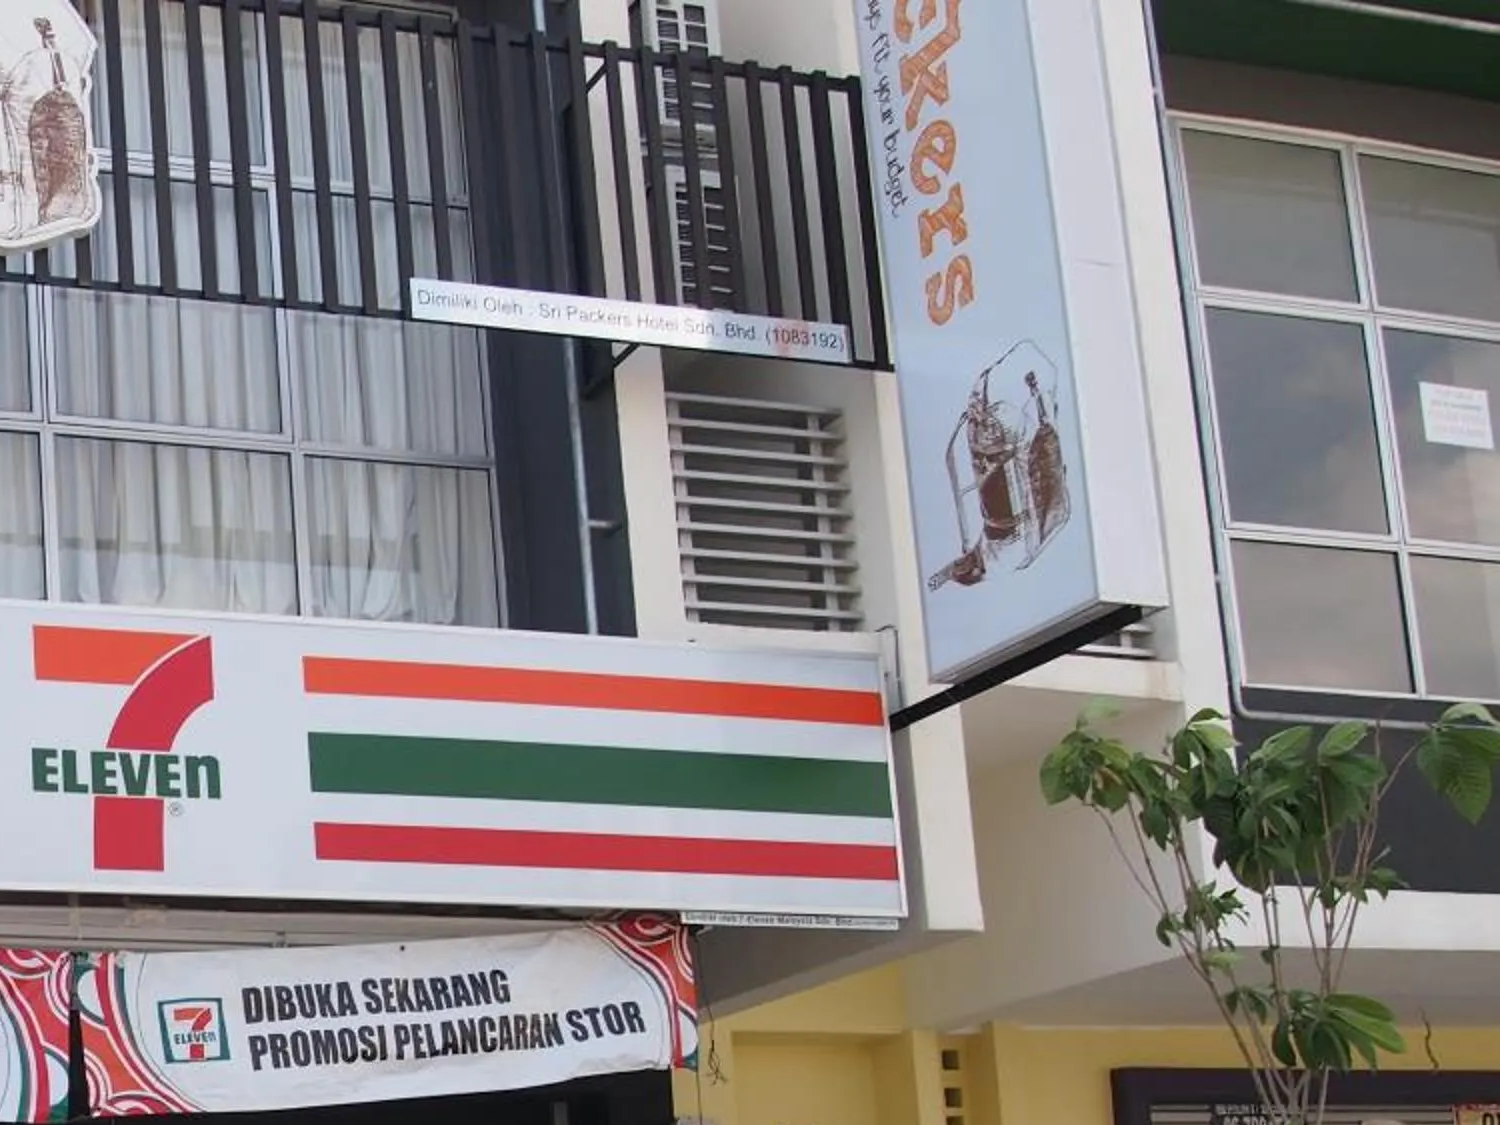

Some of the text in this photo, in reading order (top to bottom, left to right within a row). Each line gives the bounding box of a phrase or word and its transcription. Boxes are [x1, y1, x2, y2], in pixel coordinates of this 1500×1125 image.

[883, 128, 909, 219] budget
[566, 305, 633, 329] Packers
[637, 313, 679, 331] Hotel
[765, 327, 845, 353] (1083192)
[241, 969, 512, 1024] DIBUKA SEKARANG
[248, 1001, 647, 1071] PROMOSI PELANCARAN STOR
